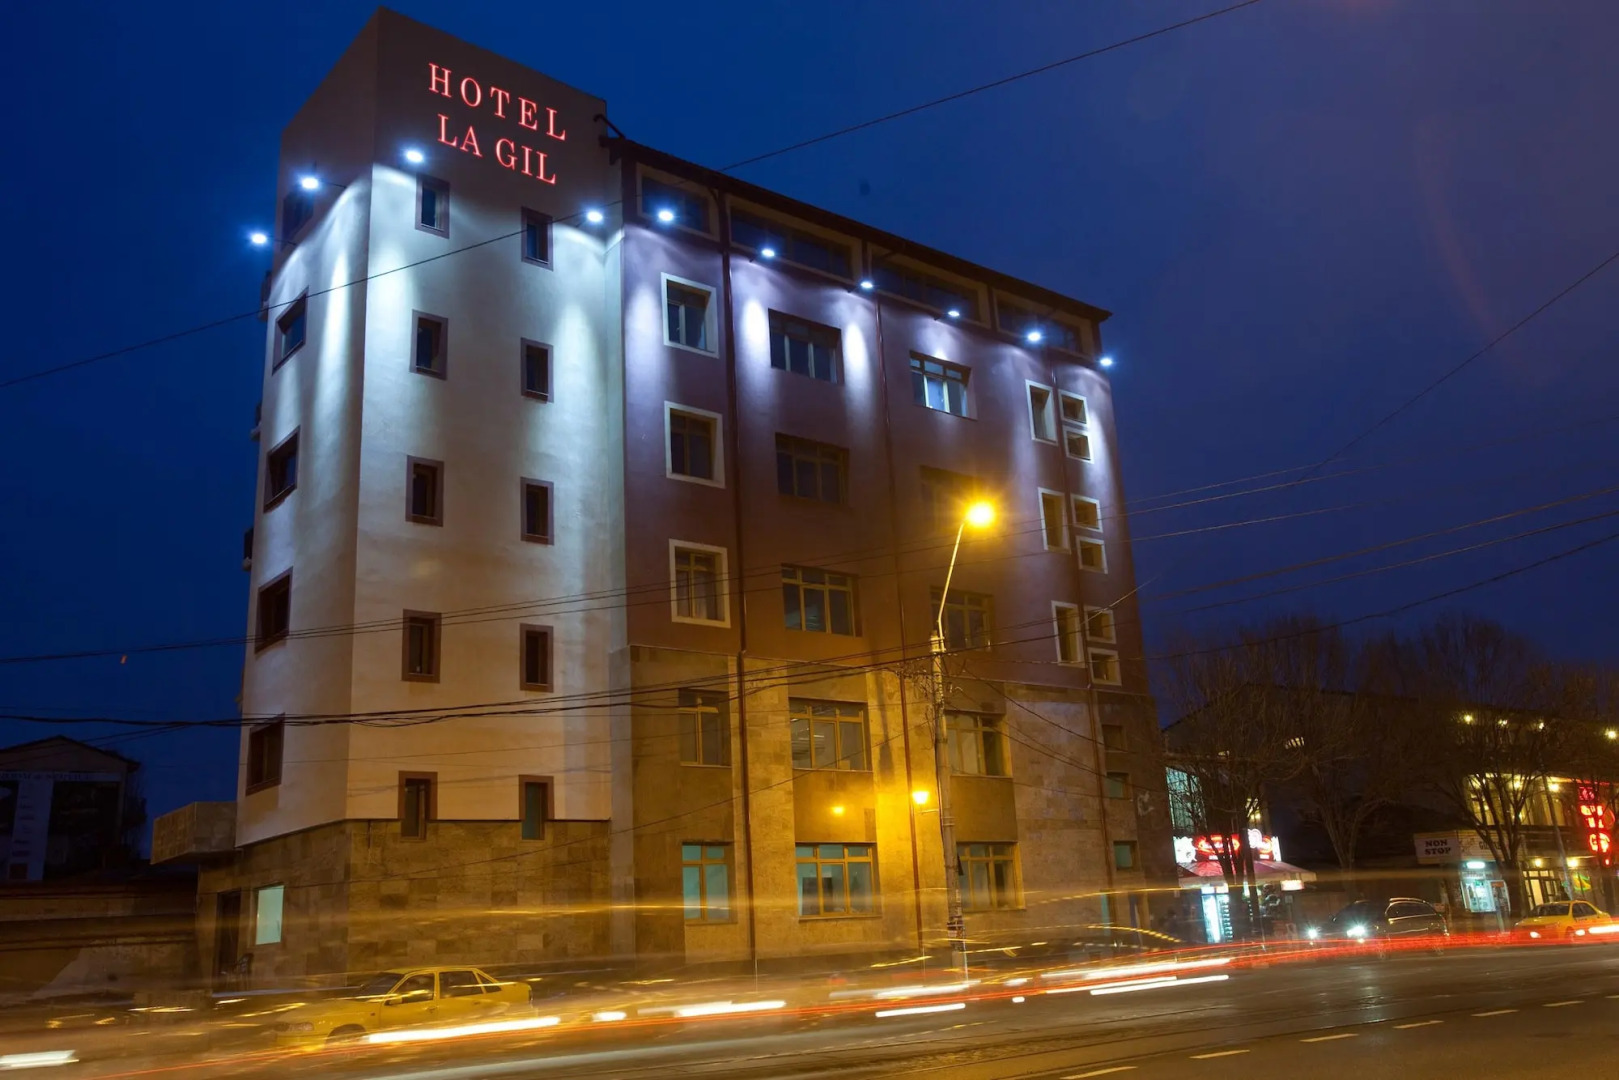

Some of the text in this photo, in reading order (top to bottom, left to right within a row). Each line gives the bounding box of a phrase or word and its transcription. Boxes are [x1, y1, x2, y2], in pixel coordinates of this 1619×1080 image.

[428, 62, 566, 141] HOTEL
[437, 113, 556, 185] LA GIL
[1425, 839, 1448, 848] NON
[1425, 847, 1451, 856] STOP
